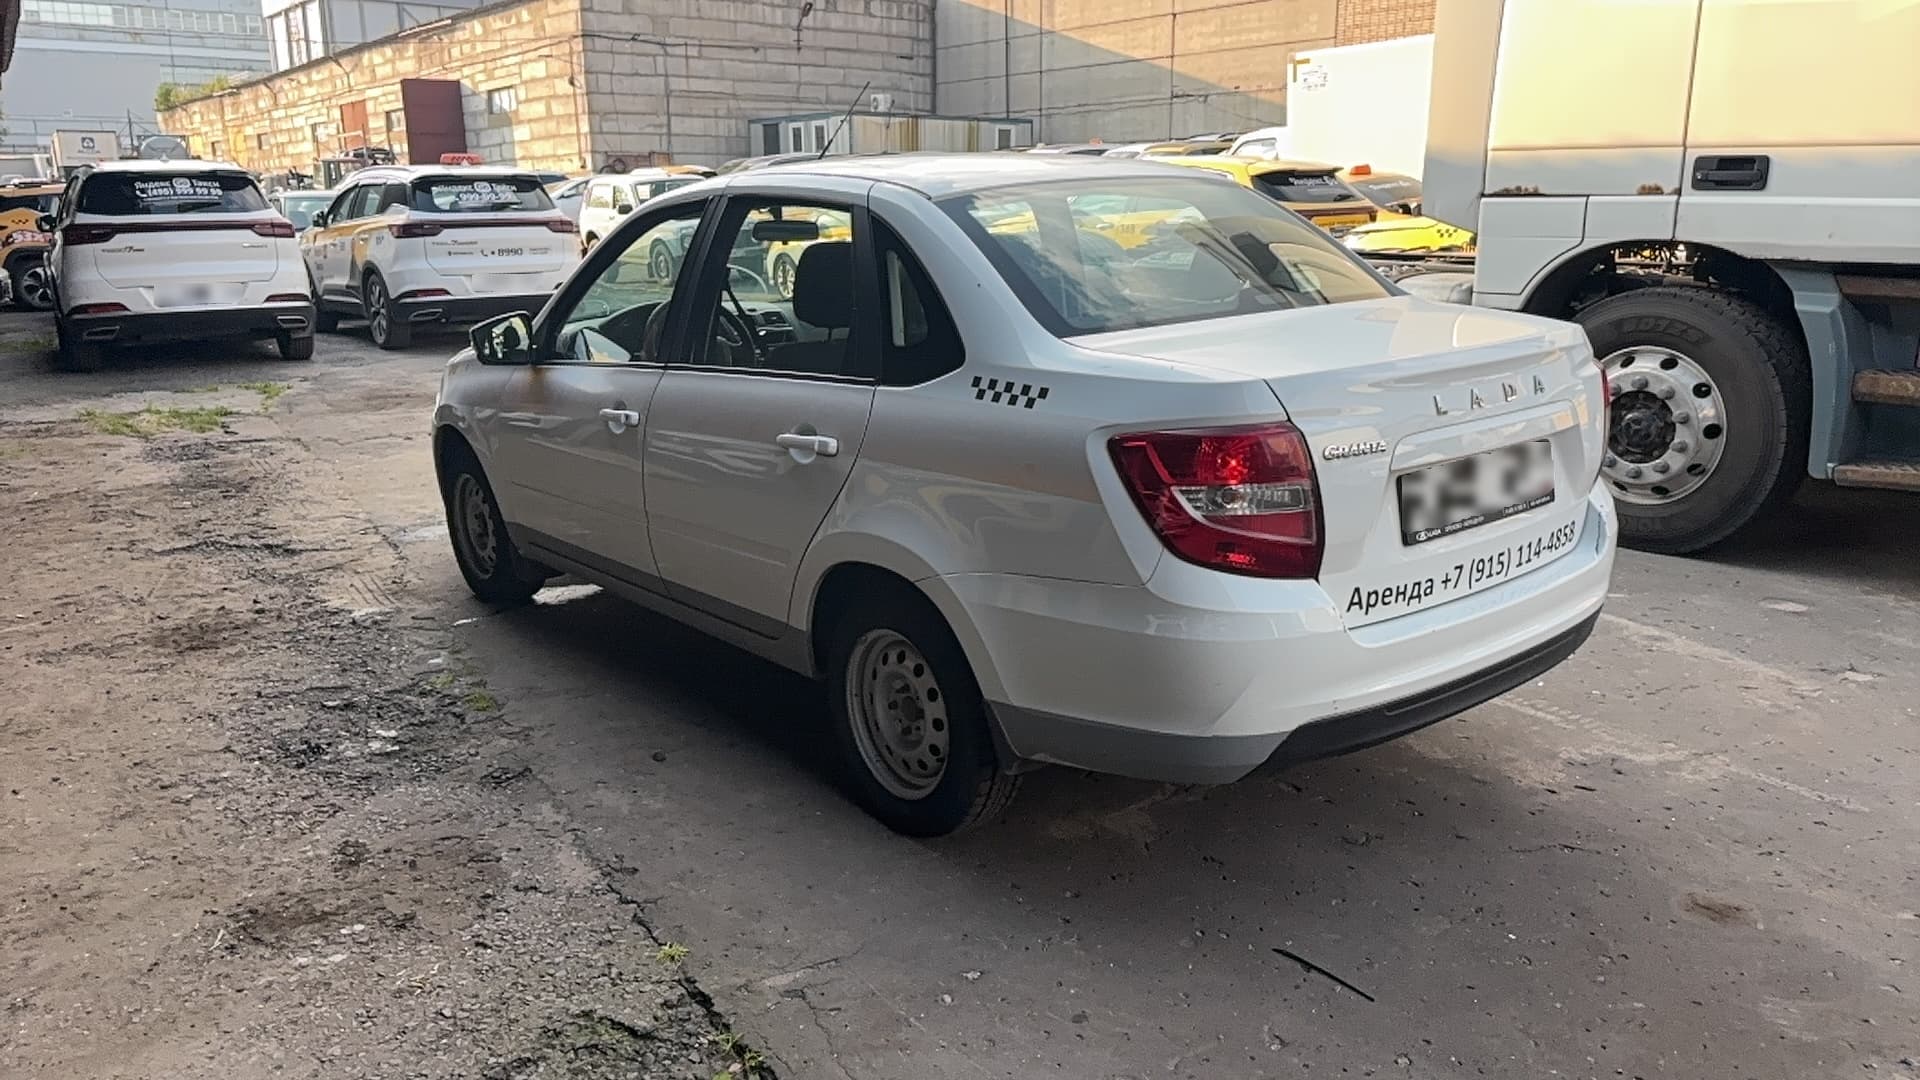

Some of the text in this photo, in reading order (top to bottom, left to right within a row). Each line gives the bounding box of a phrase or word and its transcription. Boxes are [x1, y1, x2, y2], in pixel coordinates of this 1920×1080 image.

[1433, 375, 1546, 416] LADA
[1322, 440, 1387, 461] GRANTA
[1346, 577, 1434, 615] Аренда
[1441, 564, 1464, 590] +7
[1468, 547, 1512, 590] (915)
[1515, 520, 1576, 568] 114-4858
